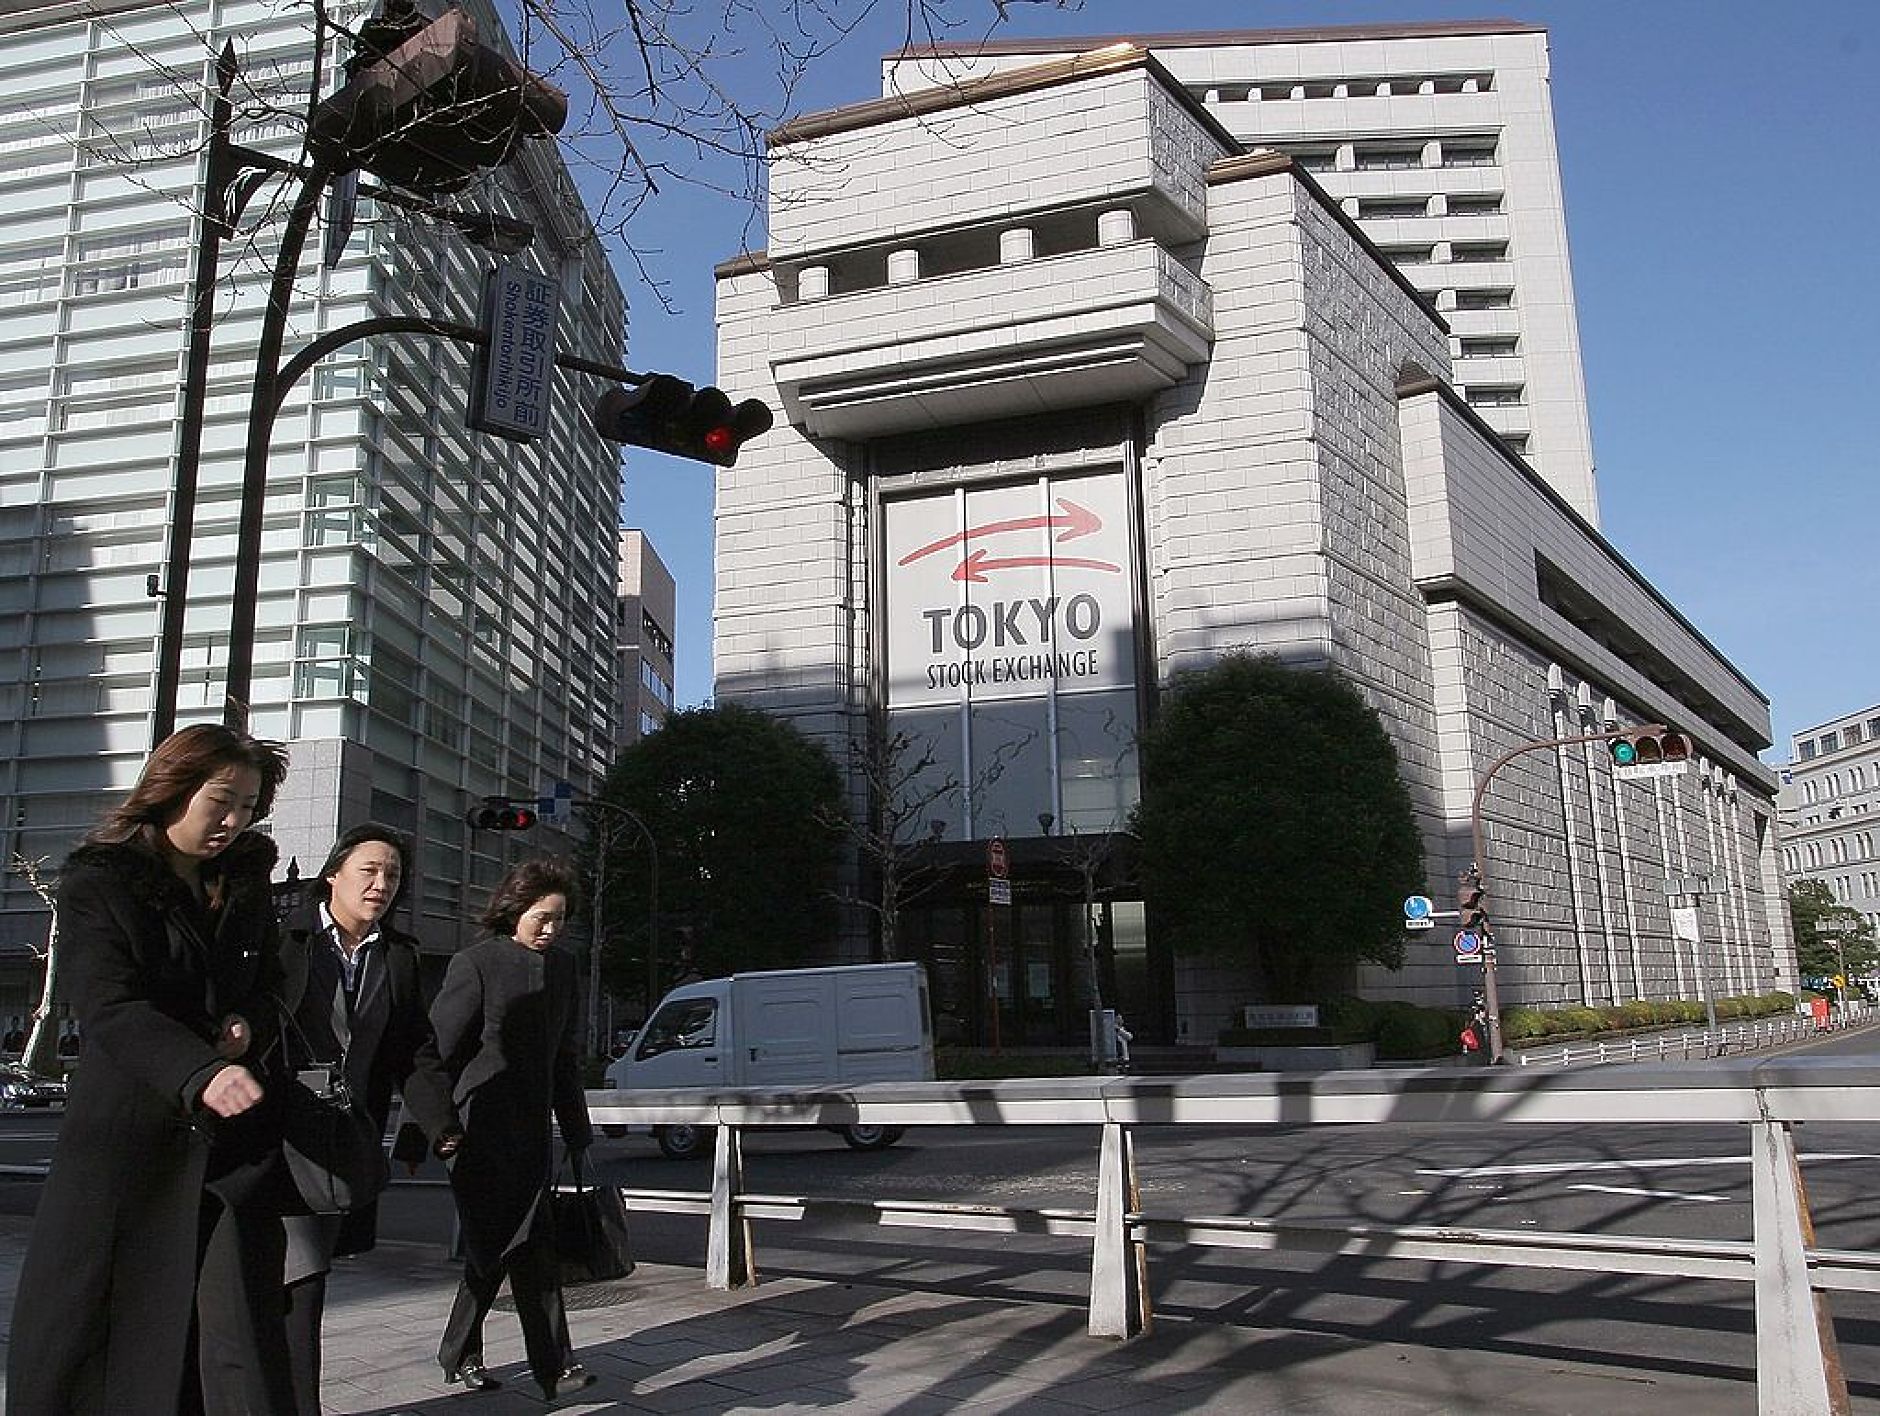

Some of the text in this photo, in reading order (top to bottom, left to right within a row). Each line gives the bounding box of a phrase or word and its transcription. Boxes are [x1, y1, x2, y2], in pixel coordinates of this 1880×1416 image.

[513, 279, 552, 427] 証券取引所前
[922, 592, 1101, 654] TOKYO
[926, 649, 1099, 689] STOCK EXCHANGE
